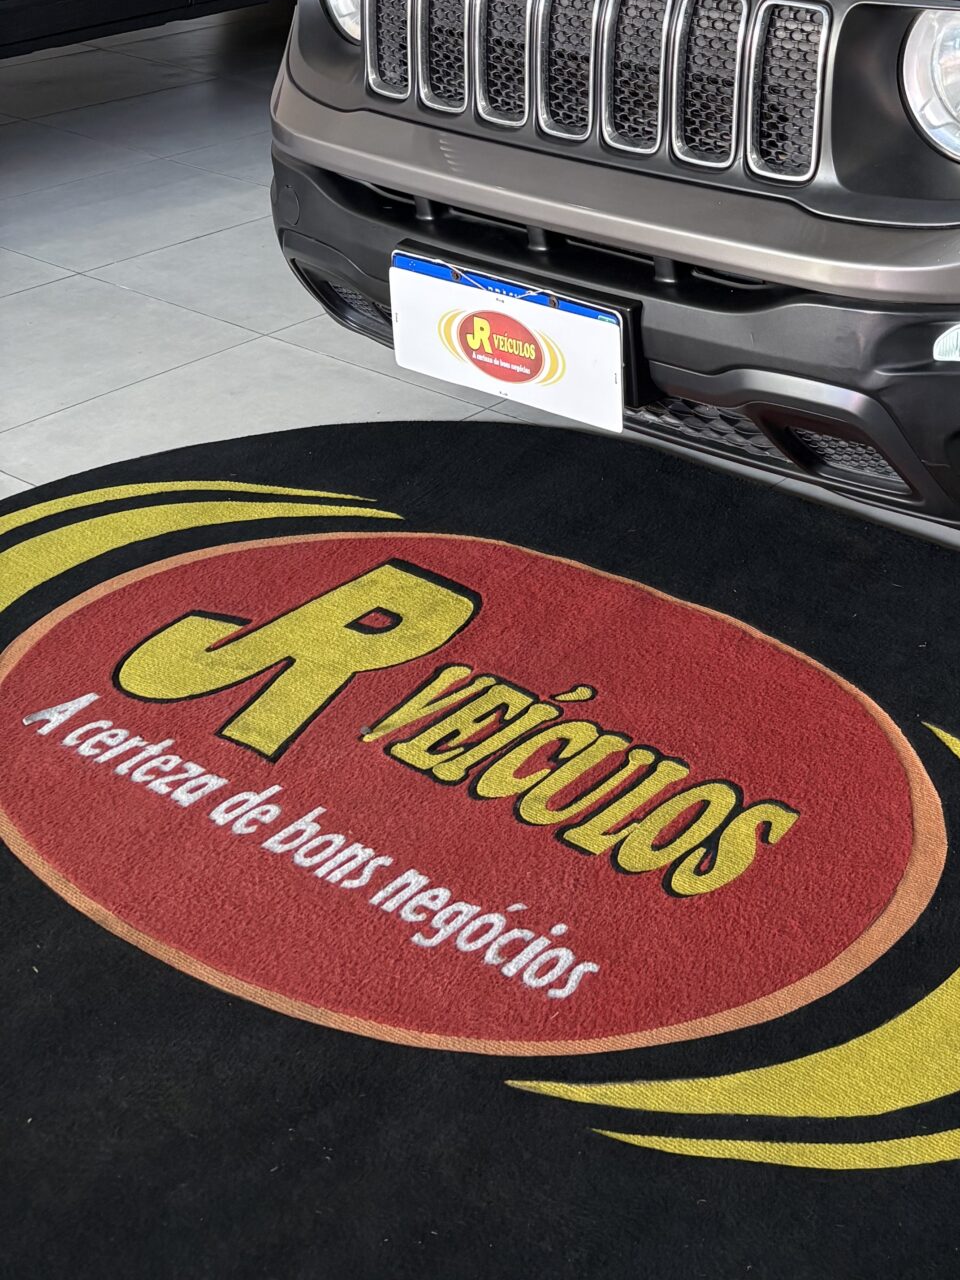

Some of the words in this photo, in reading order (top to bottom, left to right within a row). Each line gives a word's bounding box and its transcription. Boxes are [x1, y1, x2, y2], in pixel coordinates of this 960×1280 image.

[465, 316, 492, 354] JR
[493, 333, 536, 360] VEÍCULOS
[22, 692, 100, 736] A
[62, 720, 229, 808] certeza
[209, 784, 282, 836] de
[261, 806, 393, 889] bons
[369, 869, 600, 999] negócios
[113, 558, 481, 761] JR
[359, 663, 800, 898] VEÍCULOS
